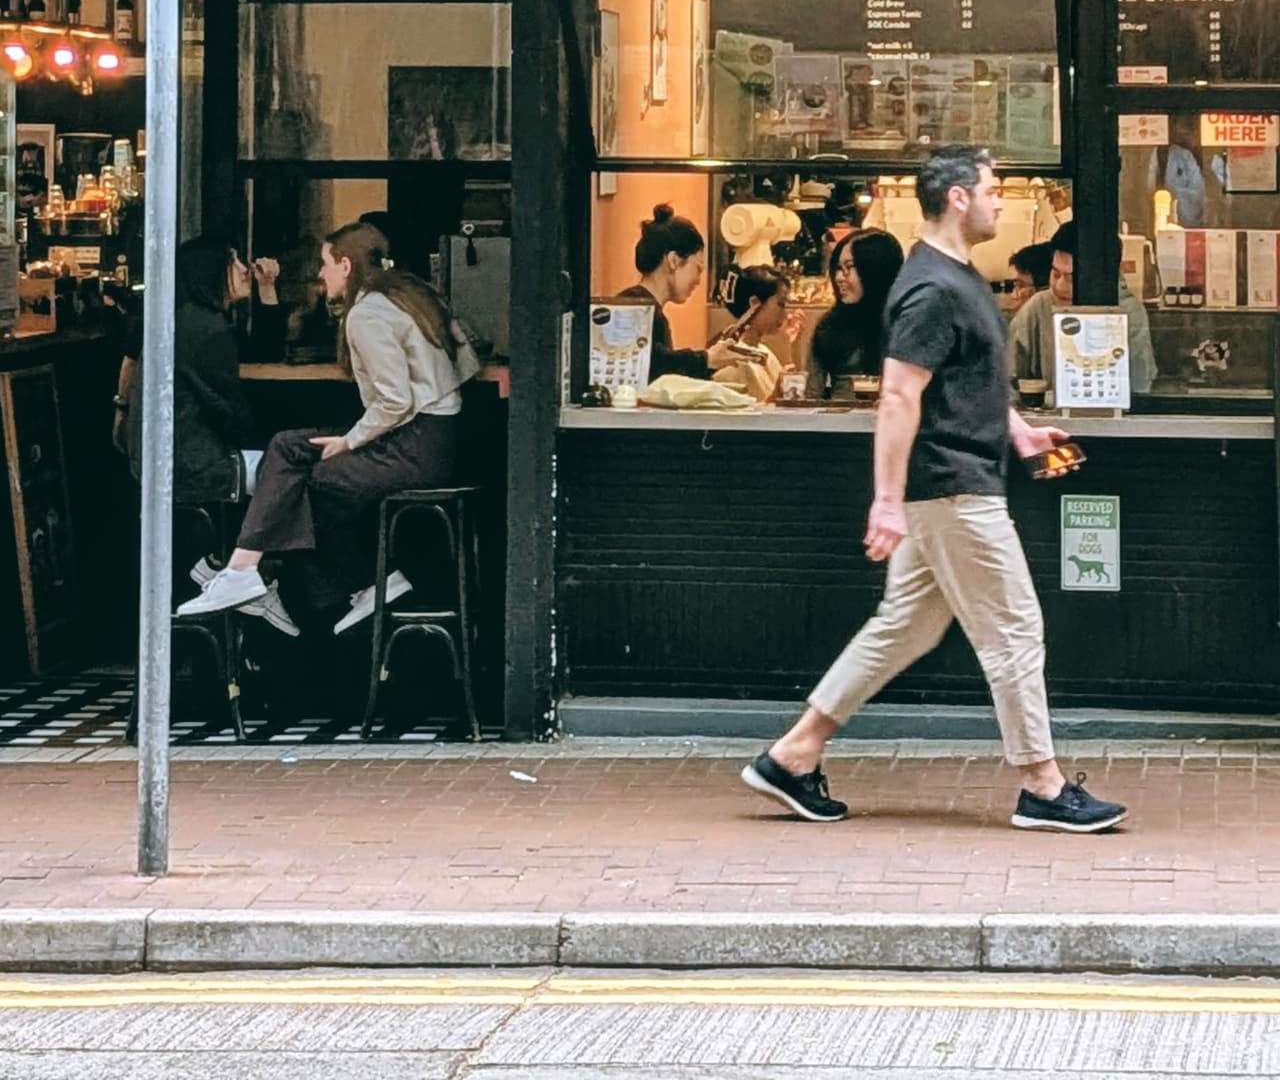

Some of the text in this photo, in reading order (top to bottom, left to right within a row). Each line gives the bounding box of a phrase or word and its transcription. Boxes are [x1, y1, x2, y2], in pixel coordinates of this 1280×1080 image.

[1215, 125, 1267, 142] HERE
[1067, 501, 1113, 514] RESERVED
[1070, 514, 1111, 527] PARKING
[1082, 532, 1098, 542] FOR
[1078, 544, 1102, 554] DOGS
